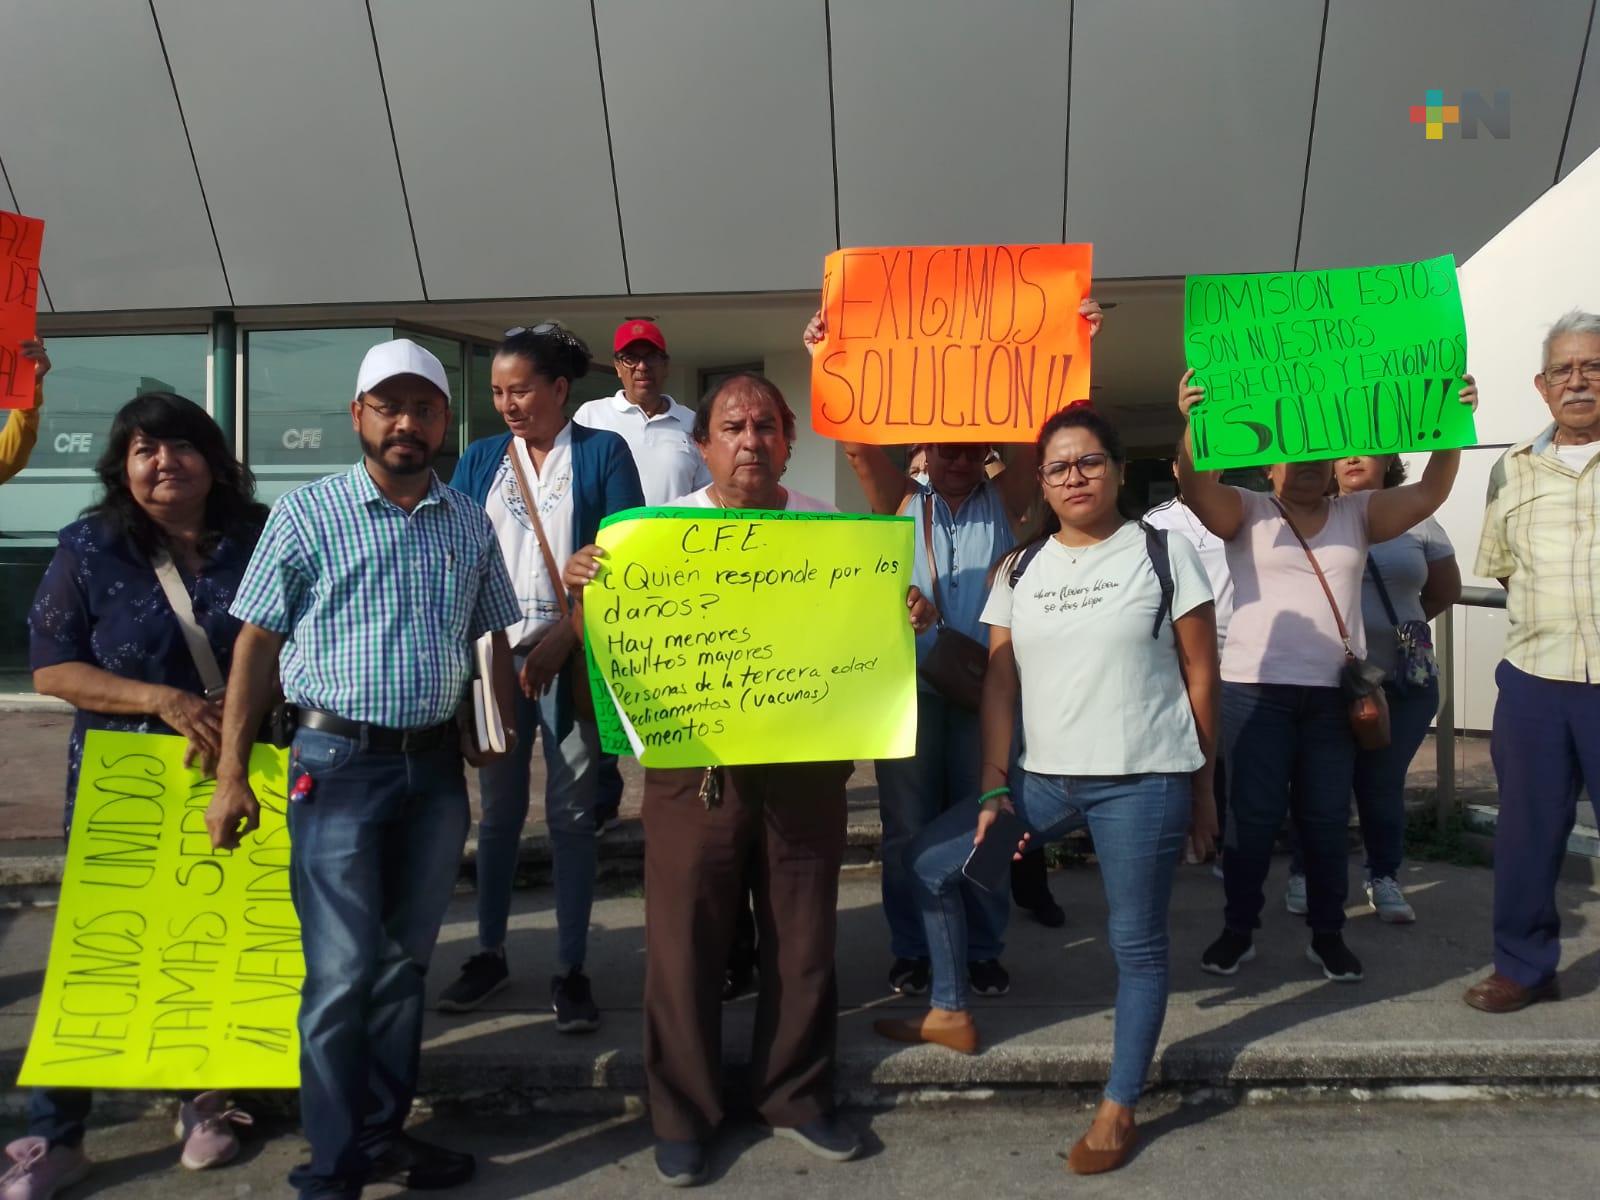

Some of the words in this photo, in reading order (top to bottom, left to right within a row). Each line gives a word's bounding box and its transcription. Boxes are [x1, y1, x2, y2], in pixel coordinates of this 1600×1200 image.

[1189, 273, 1334, 327] COMISION
[1357, 262, 1451, 306] ESTOS
[1189, 331, 1239, 371] SON
[1245, 315, 1376, 366] NUESTROS
[1336, 357, 1348, 386] Y
[54, 432, 93, 454] CFE
[281, 428, 322, 450] CFE
[715, 559, 818, 593] responde
[829, 566, 862, 589] por
[874, 554, 899, 575] los
[607, 630, 653, 668] Hay
[665, 627, 752, 649] menores
[697, 644, 774, 672] mayores
[695, 671, 714, 692] de
[722, 673, 734, 689] la
[739, 665, 821, 688] tercera
[831, 656, 879, 676] edad
[626, 697, 731, 726] edicamentos
[79, 752, 167, 890] UNIDOS
[40, 909, 148, 1067] VECINOS
